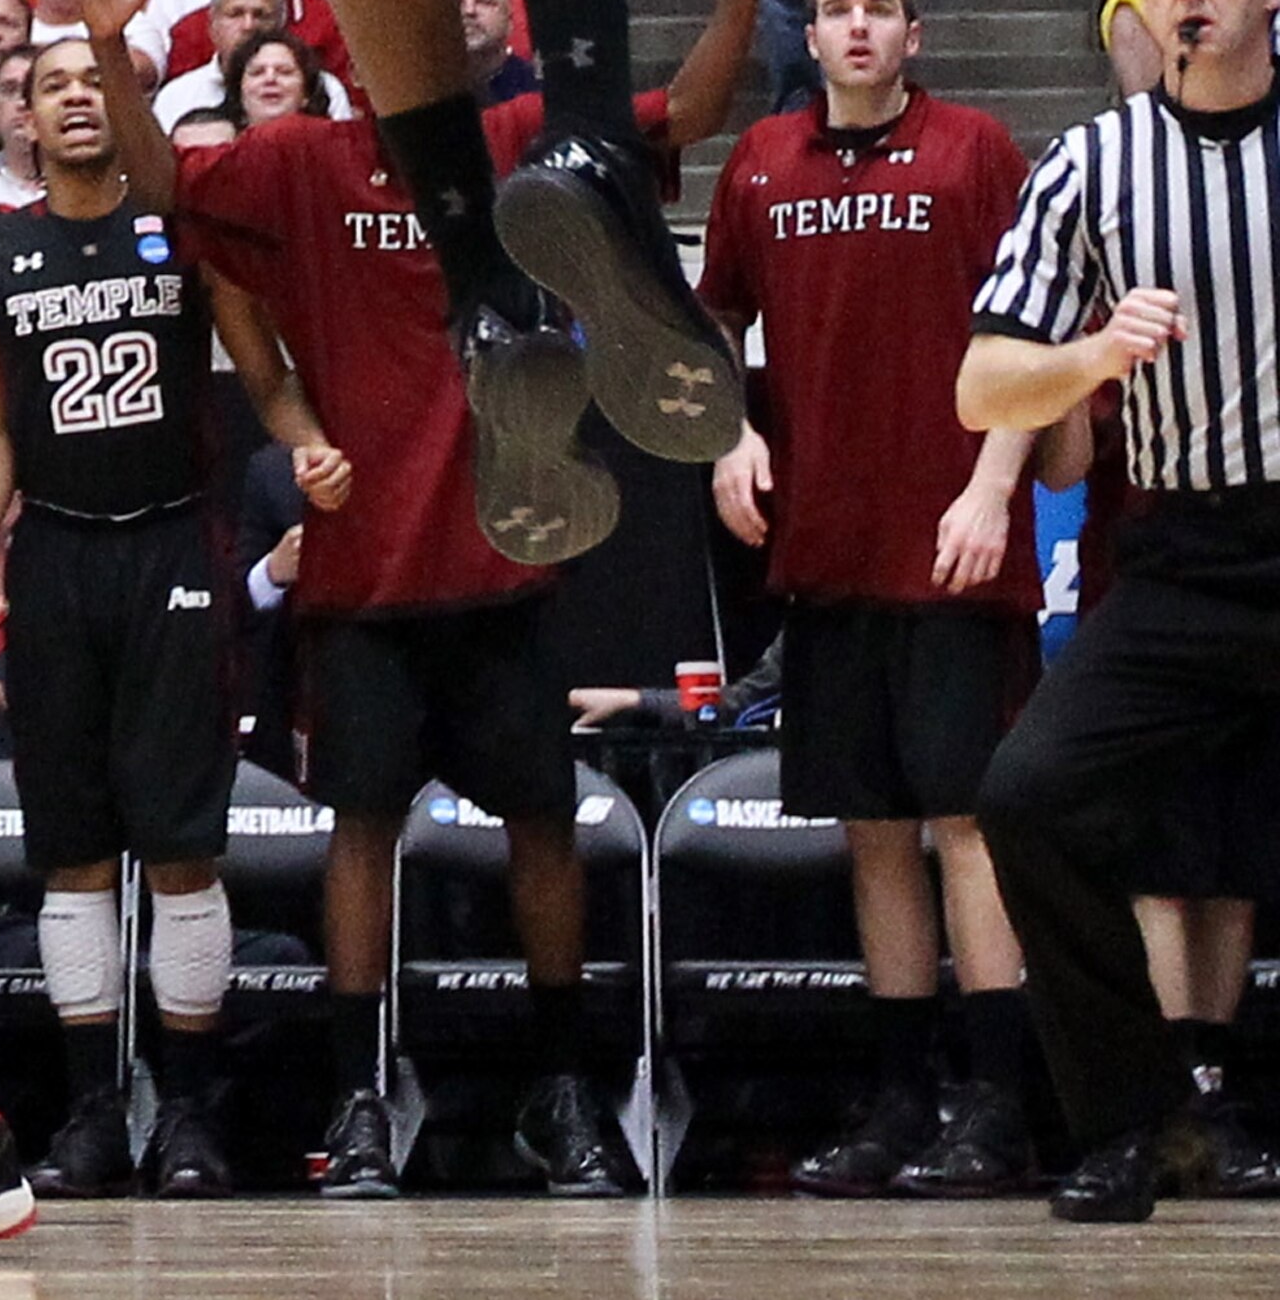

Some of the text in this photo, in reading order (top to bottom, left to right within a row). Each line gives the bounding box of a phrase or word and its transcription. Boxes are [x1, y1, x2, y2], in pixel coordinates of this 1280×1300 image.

[769, 193, 933, 240] TEMPLE
[6, 274, 183, 336] TEMPLE
[43, 330, 164, 434] 22
